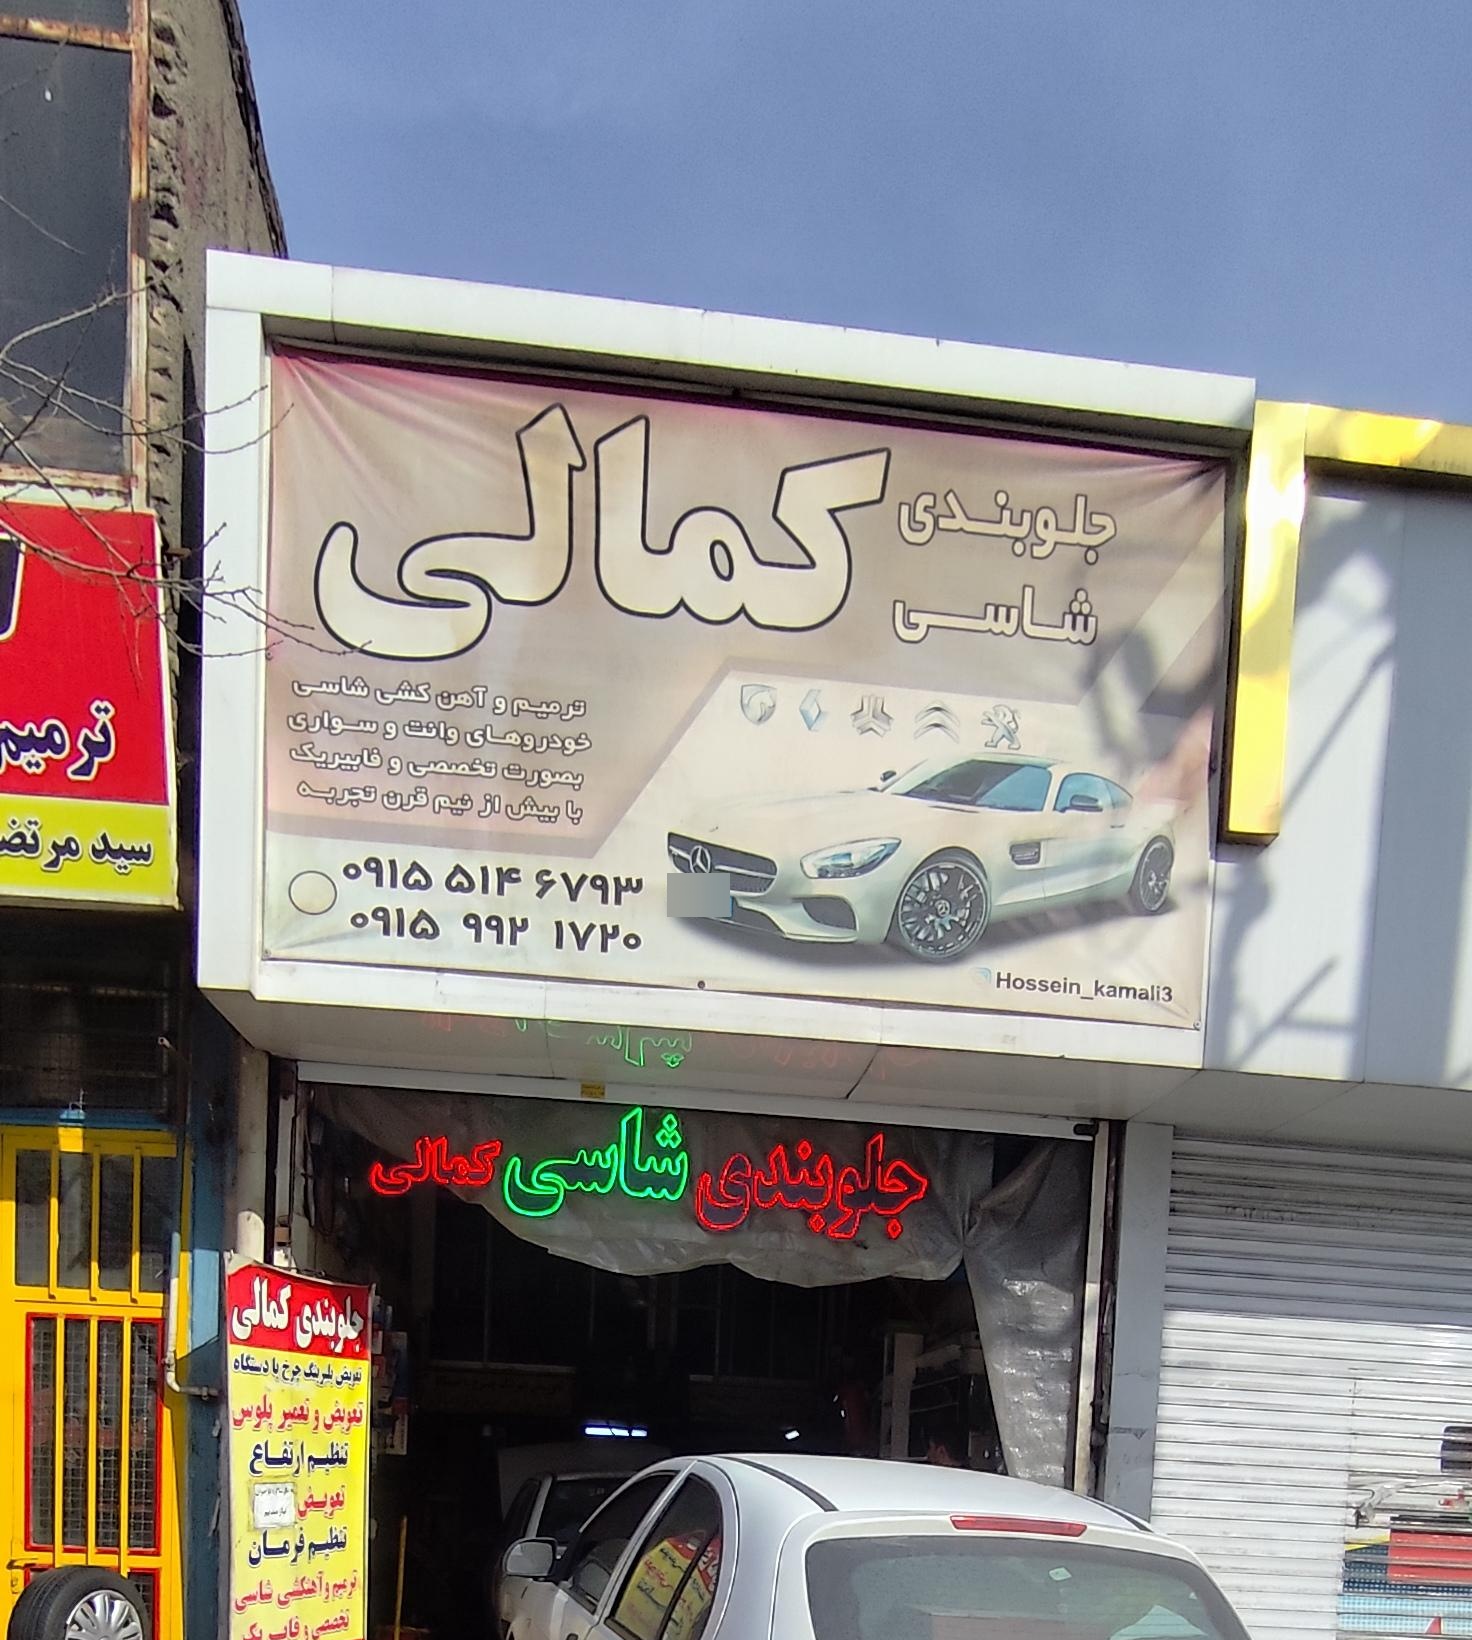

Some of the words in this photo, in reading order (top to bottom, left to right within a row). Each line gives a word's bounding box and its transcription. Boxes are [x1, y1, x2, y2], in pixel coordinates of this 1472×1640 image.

[313, 402, 891, 661] کمالی
[898, 488, 1117, 564] جلوبندی
[892, 585, 1097, 645] شاسی
[291, 676, 369, 698] شاسی
[375, 682, 431, 705] کشی
[436, 686, 487, 710] آهن
[492, 695, 507, 715] و
[511, 696, 586, 720] ترمیم
[287, 710, 378, 735] سواری
[383, 719, 398, 739] و
[404, 721, 459, 745] وانت
[464, 725, 593, 755] خودروهای
[388, 755, 402, 774] و
[407, 755, 497, 778] تخصصی
[502, 763, 584, 791] بصورت
[297, 780, 377, 807] تجربه
[382, 787, 428, 811] قرن
[432, 793, 472, 816] نیم
[478, 794, 501, 818] از
[505, 796, 560, 823] بیش
[566, 800, 583, 825] با
[0, 816, 82, 872] مرتض
[90, 830, 153, 874] سید
[342, 856, 434, 892] ۰۹۱۵
[444, 863, 523, 897] ۵۱۴
[535, 868, 644, 906] ۶۷۹۳
[350, 906, 441, 940] ۰۹۱۵
[461, 912, 530, 946] ۹۹۲
[554, 919, 642, 953] ۱۷۲۰
[995, 970, 1173, 1004] Hossein_kamali3
[369, 1135, 502, 1196] کمالی
[503, 1106, 690, 1218] شاسی
[694, 1132, 929, 1240] جلوبندی
[232, 1277, 292, 1341] کمالی
[295, 1296, 365, 1353] جلوبندی
[233, 1353, 269, 1373] دستگاه
[312, 1408, 320, 1432] و
[322, 1401, 364, 1432] تعویض
[249, 1439, 305, 1476] ارتفاع
[306, 1441, 349, 1474] تنظیم
[296, 1484, 345, 1520] تعویض
[248, 1526, 305, 1566] فرمان
[306, 1526, 348, 1562] تنظیم
[235, 1579, 274, 1612] شاسی
